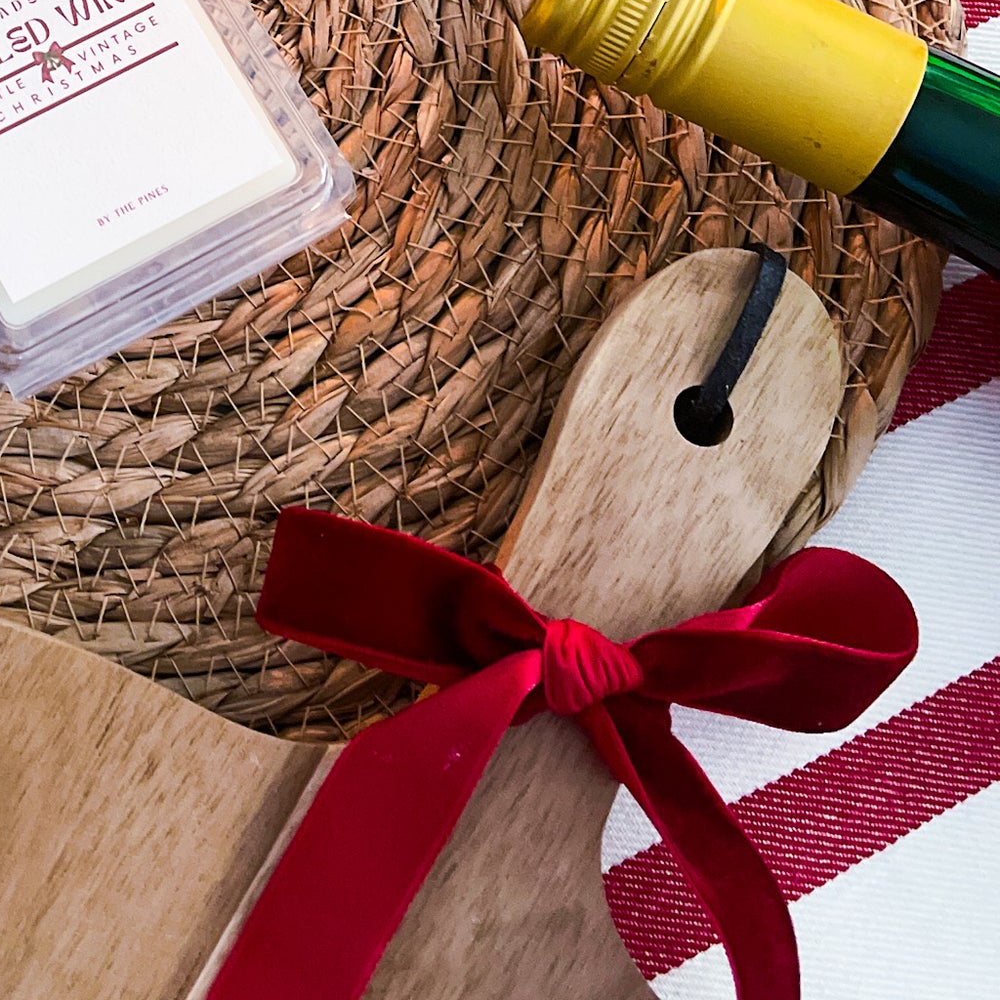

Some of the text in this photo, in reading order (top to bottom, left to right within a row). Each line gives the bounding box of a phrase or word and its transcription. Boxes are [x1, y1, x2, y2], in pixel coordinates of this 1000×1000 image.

[77, 14, 160, 62] VINTAGE
[96, 184, 169, 227] BY THE PINES
